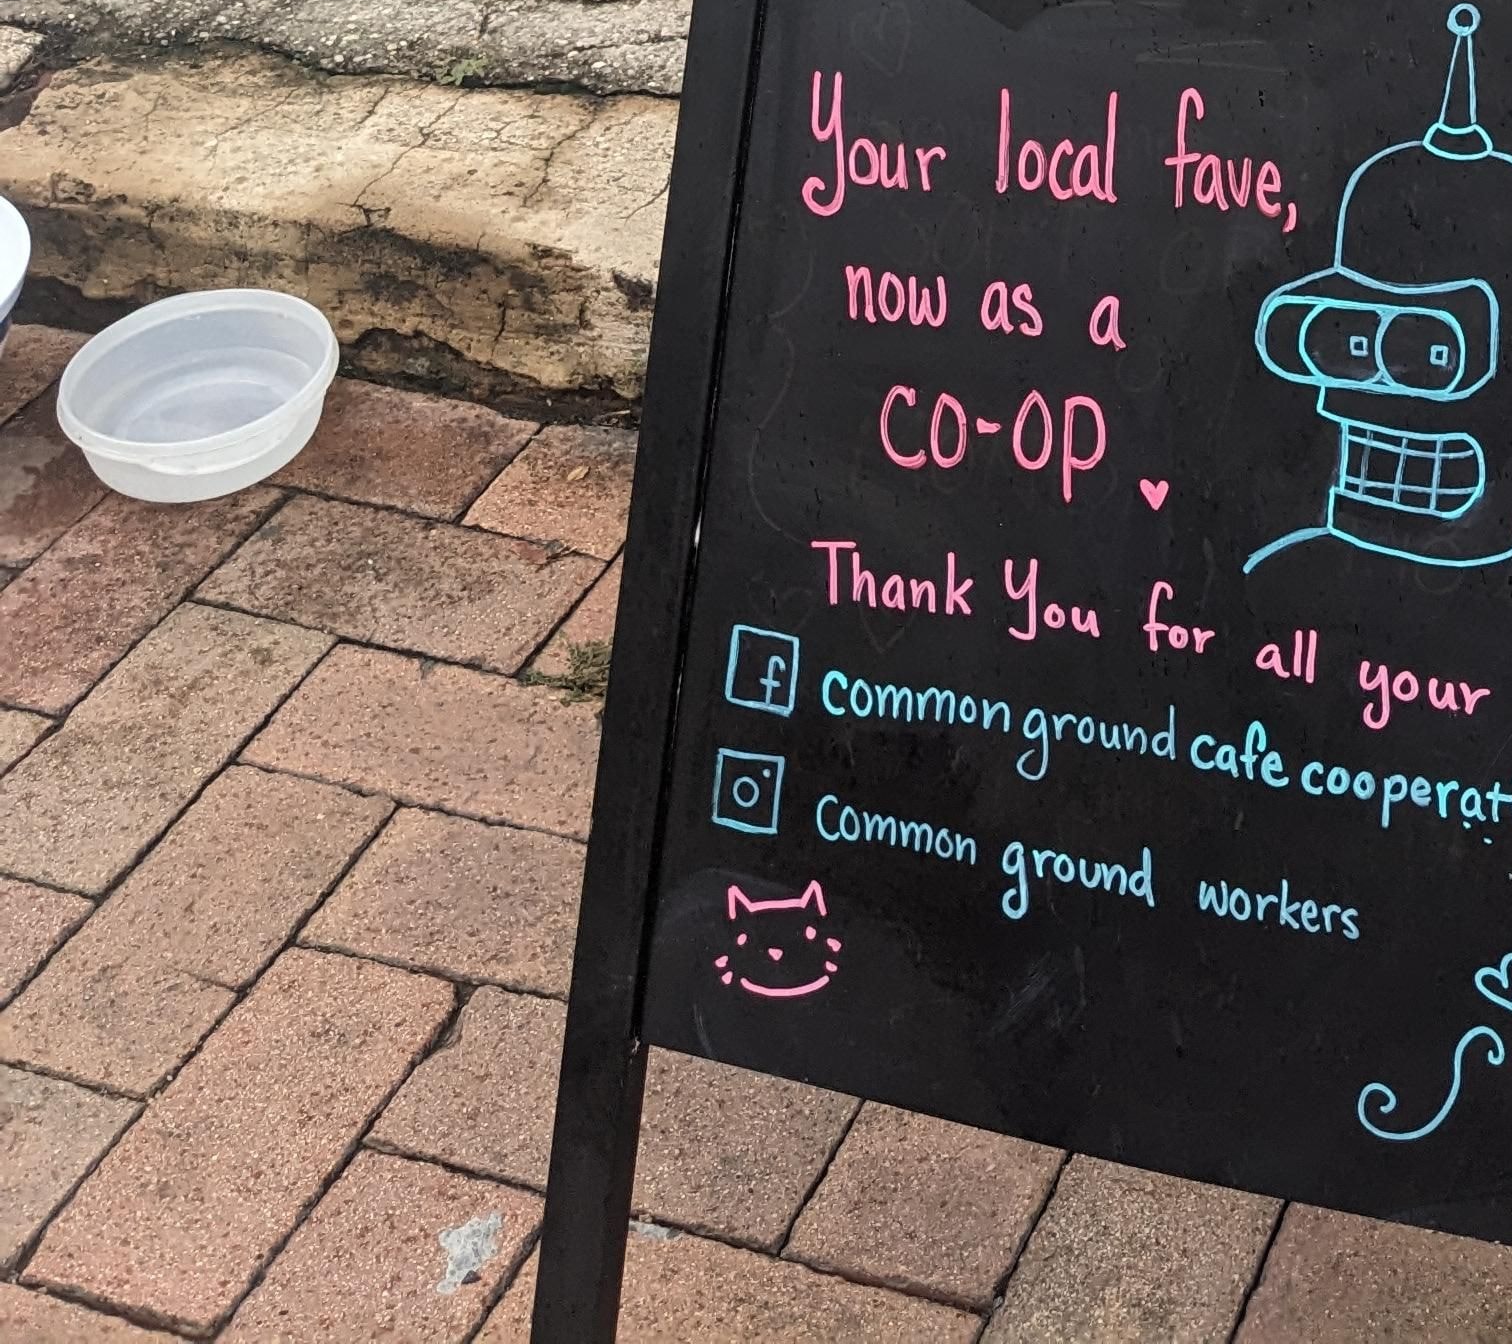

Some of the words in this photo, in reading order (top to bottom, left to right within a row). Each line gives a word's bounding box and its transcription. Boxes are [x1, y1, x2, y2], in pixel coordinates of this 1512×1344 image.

[802, 70, 947, 217] Your
[996, 87, 1118, 203] local
[1164, 87, 1298, 234] fave,
[845, 265, 948, 328] now
[980, 281, 1043, 337] as
[1088, 295, 1126, 352] a
[811, 539, 976, 615] Thank
[1142, 580, 1216, 654] for
[1255, 629, 1318, 684] all
[1358, 660, 1491, 730] your
[1015, 704, 1178, 782] ground
[1190, 720, 1290, 788] cafe
[1001, 839, 1156, 920] ground
[1198, 878, 1361, 941] workers
